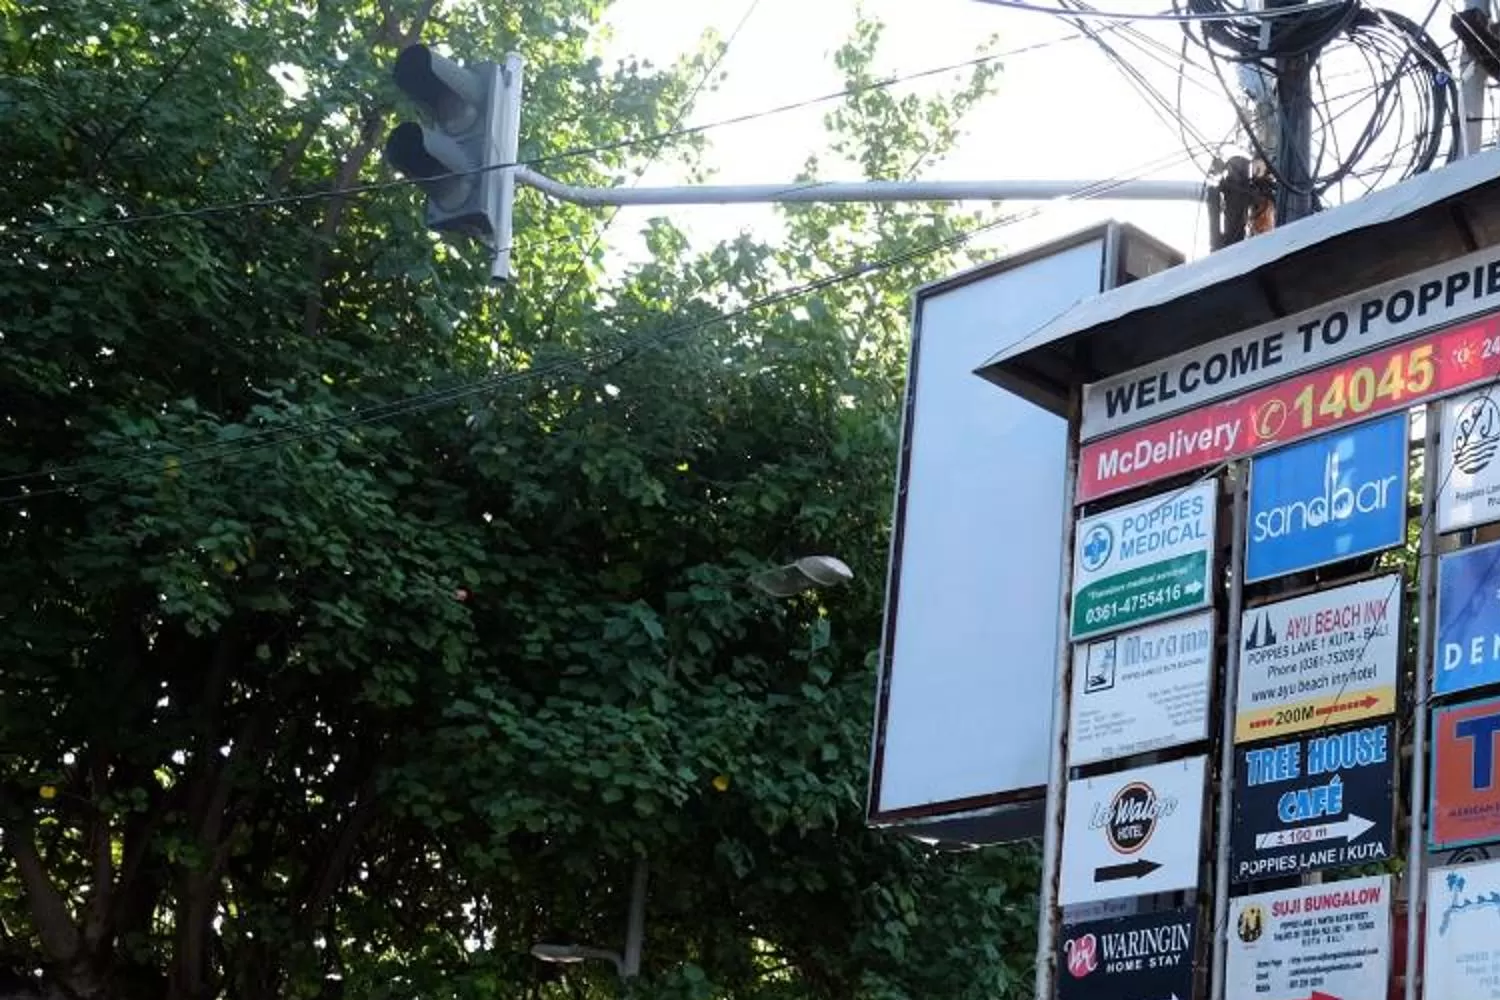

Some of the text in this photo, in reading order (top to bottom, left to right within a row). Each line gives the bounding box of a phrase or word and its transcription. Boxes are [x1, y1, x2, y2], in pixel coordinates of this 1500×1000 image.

[1105, 332, 1284, 420] WELCOME
[1297, 311, 1349, 355] TO
[1097, 418, 1242, 481] McDelivery
[1294, 344, 1435, 429] 14045
[1480, 333, 1500, 358] 24
[1122, 496, 1204, 537] POPPIES
[1253, 451, 1397, 542] sandbar
[1120, 522, 1208, 561] MEDICAL
[1085, 584, 1181, 624] 0361-4755416
[1286, 600, 1388, 641] AYU BEACH INN
[1248, 645, 1289, 665] POPPIES
[1292, 639, 1318, 657] LANE
[1328, 631, 1355, 648] KUTA
[1363, 624, 1389, 641] BALI
[1267, 662, 1297, 679] Phone
[1276, 706, 1315, 727] 200M
[1245, 725, 1387, 787] TREE HOUSE
[1278, 774, 1344, 823] CAFÉ
[1240, 855, 1297, 876] POPPIES
[1301, 848, 1336, 868] LANE
[1347, 842, 1386, 860] KUTA
[1272, 899, 1301, 917] SUJI
[1304, 887, 1381, 912] BUNGALOW
[1102, 923, 1191, 960] WARINGIN
[1106, 954, 1181, 973] HOME STAY
